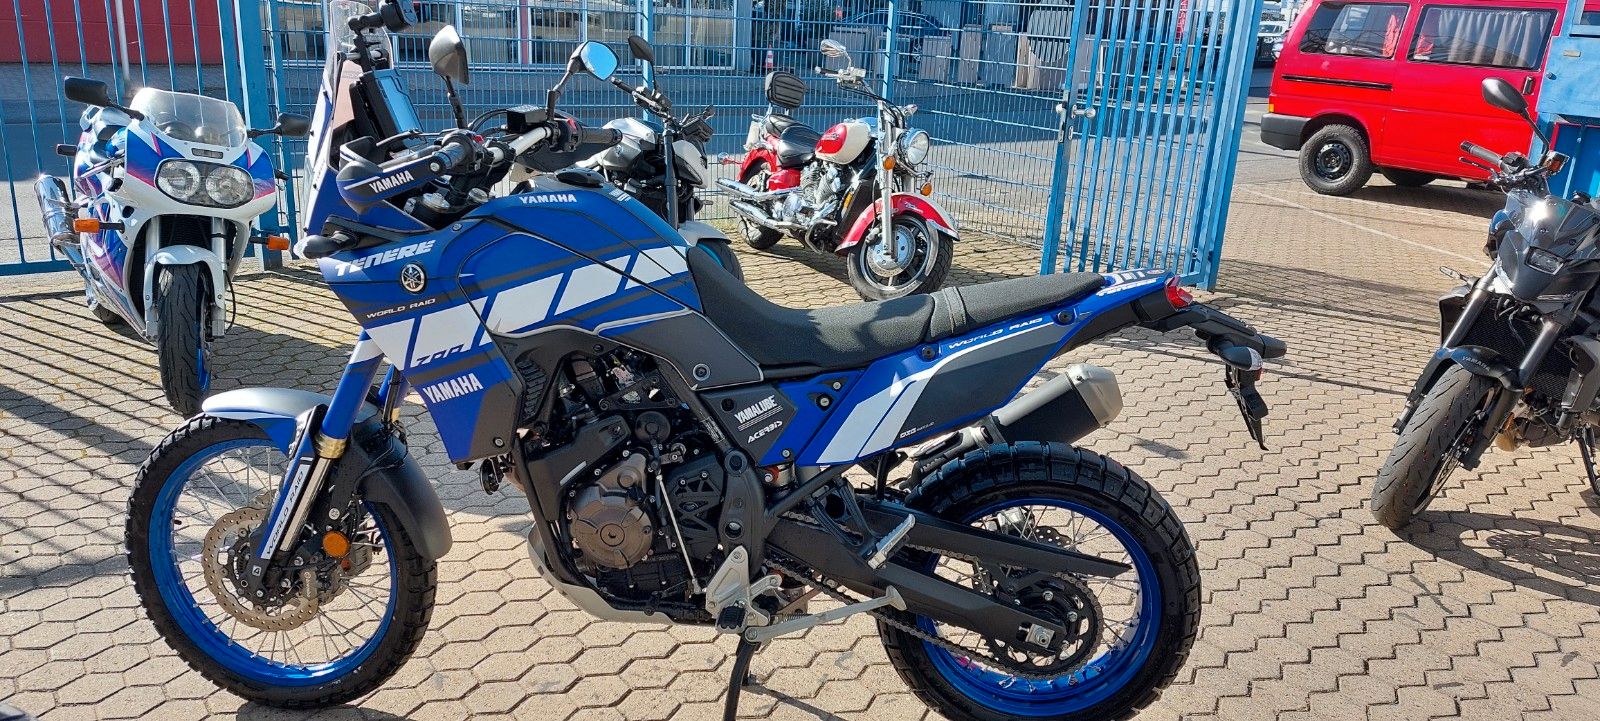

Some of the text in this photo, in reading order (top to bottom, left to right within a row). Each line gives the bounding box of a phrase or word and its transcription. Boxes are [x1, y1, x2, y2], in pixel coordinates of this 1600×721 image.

[369, 170, 414, 193] YAMAHA
[519, 193, 577, 204] YAMAHA
[335, 240, 436, 276] TENERE
[367, 298, 435, 318] WORLD RAID
[949, 318, 1042, 349] WORLD RAID
[1462, 355, 1490, 371] YAMAHA
[422, 372, 484, 403] YAMAHA
[734, 394, 777, 424] YAMALUBE
[266, 470, 304, 554] WORLD RAID
